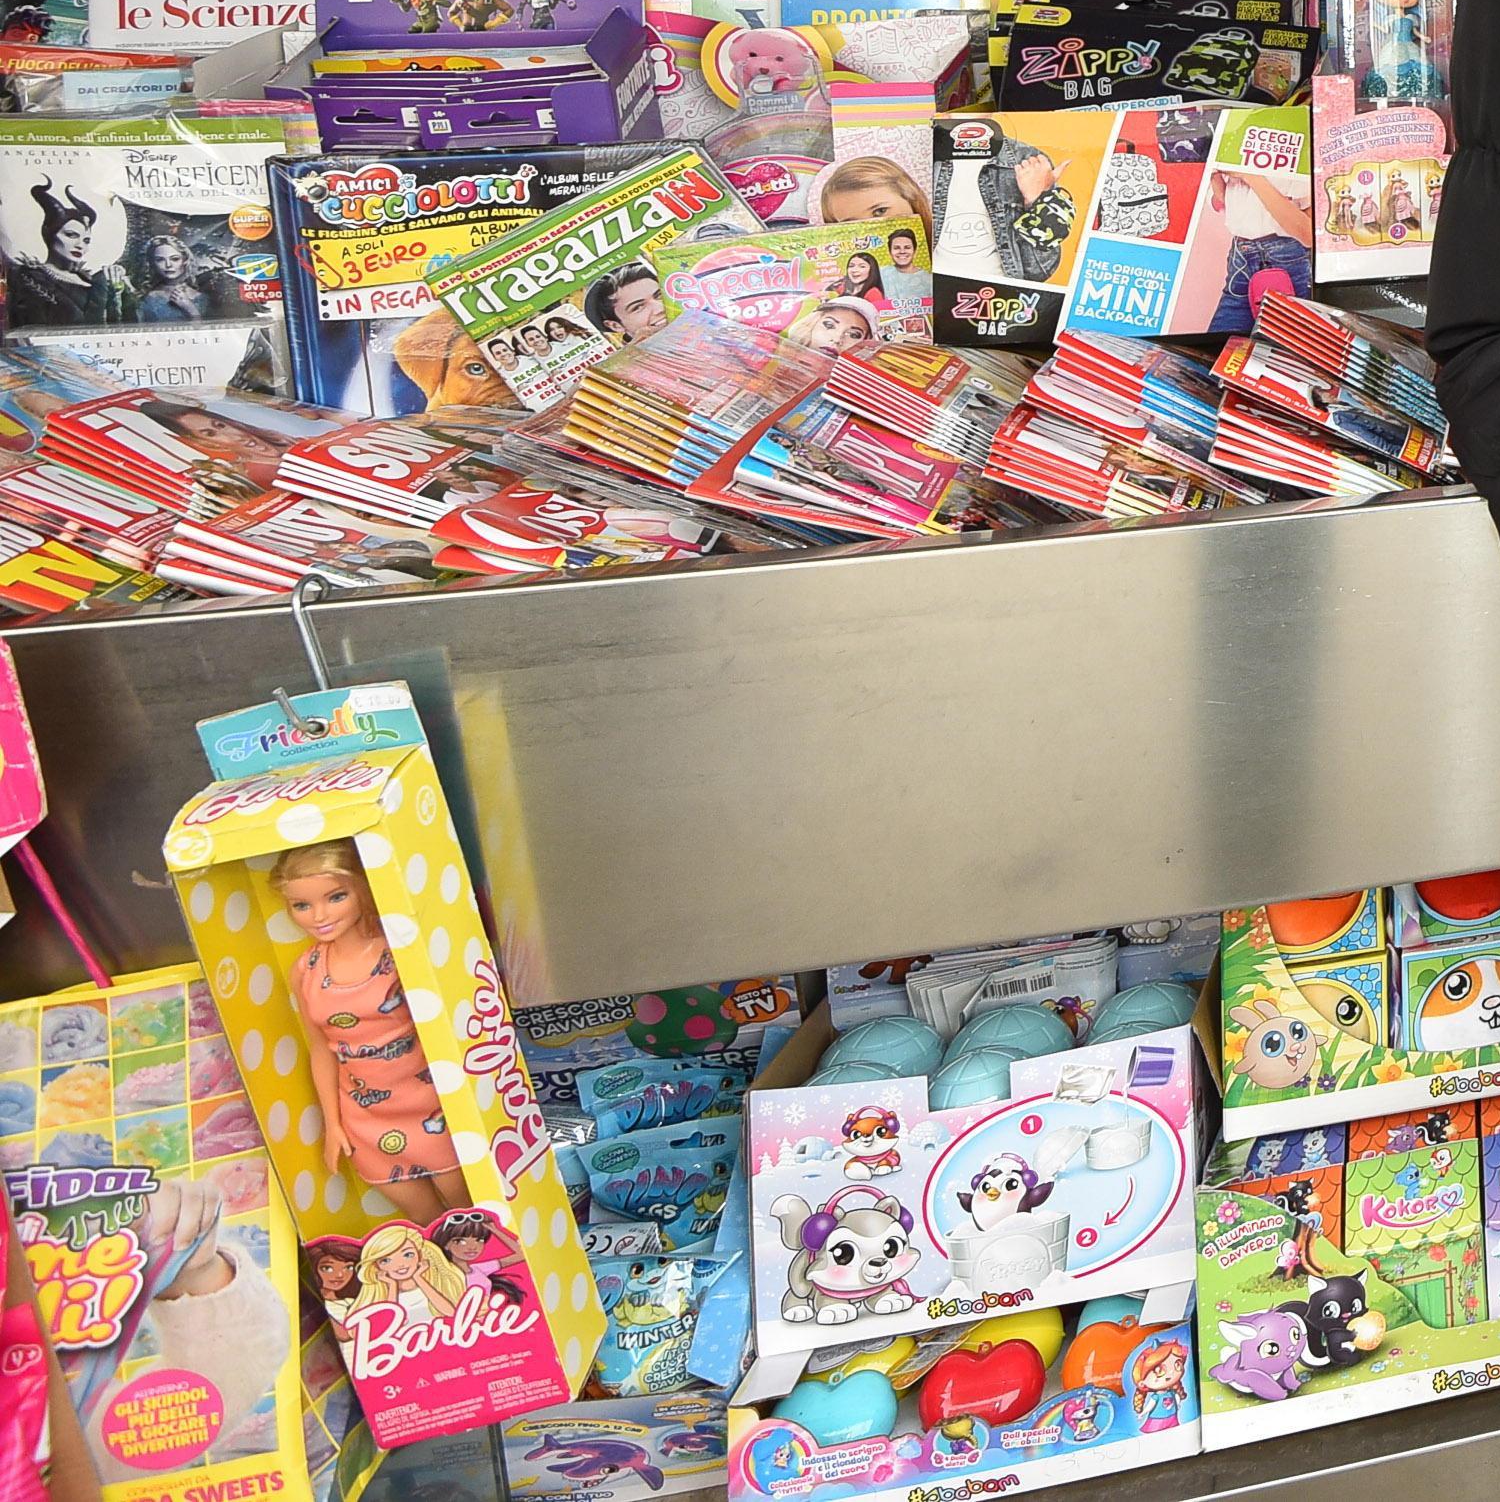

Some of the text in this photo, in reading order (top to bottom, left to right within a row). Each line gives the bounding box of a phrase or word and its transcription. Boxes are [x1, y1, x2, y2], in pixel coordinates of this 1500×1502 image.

[102, 83, 157, 94] CREATORI
[1065, 78, 1112, 98] BAG
[1246, 129, 1301, 146] SCEGLI
[1243, 151, 1295, 173] TOP!
[353, 240, 384, 256] SOLI
[363, 242, 427, 272] EURO
[1087, 259, 1171, 280] THE ORIGINAL
[1085, 282, 1165, 310] MINI
[1075, 305, 1160, 327] BACKPACK!
[516, 994, 635, 1028] CRESCONO
[529, 1005, 635, 1038] DAVVERO!
[465, 958, 551, 1195] Barbie
[347, 1305, 537, 1380] Barbie
[184, 1470, 285, 1502] SWEETS
